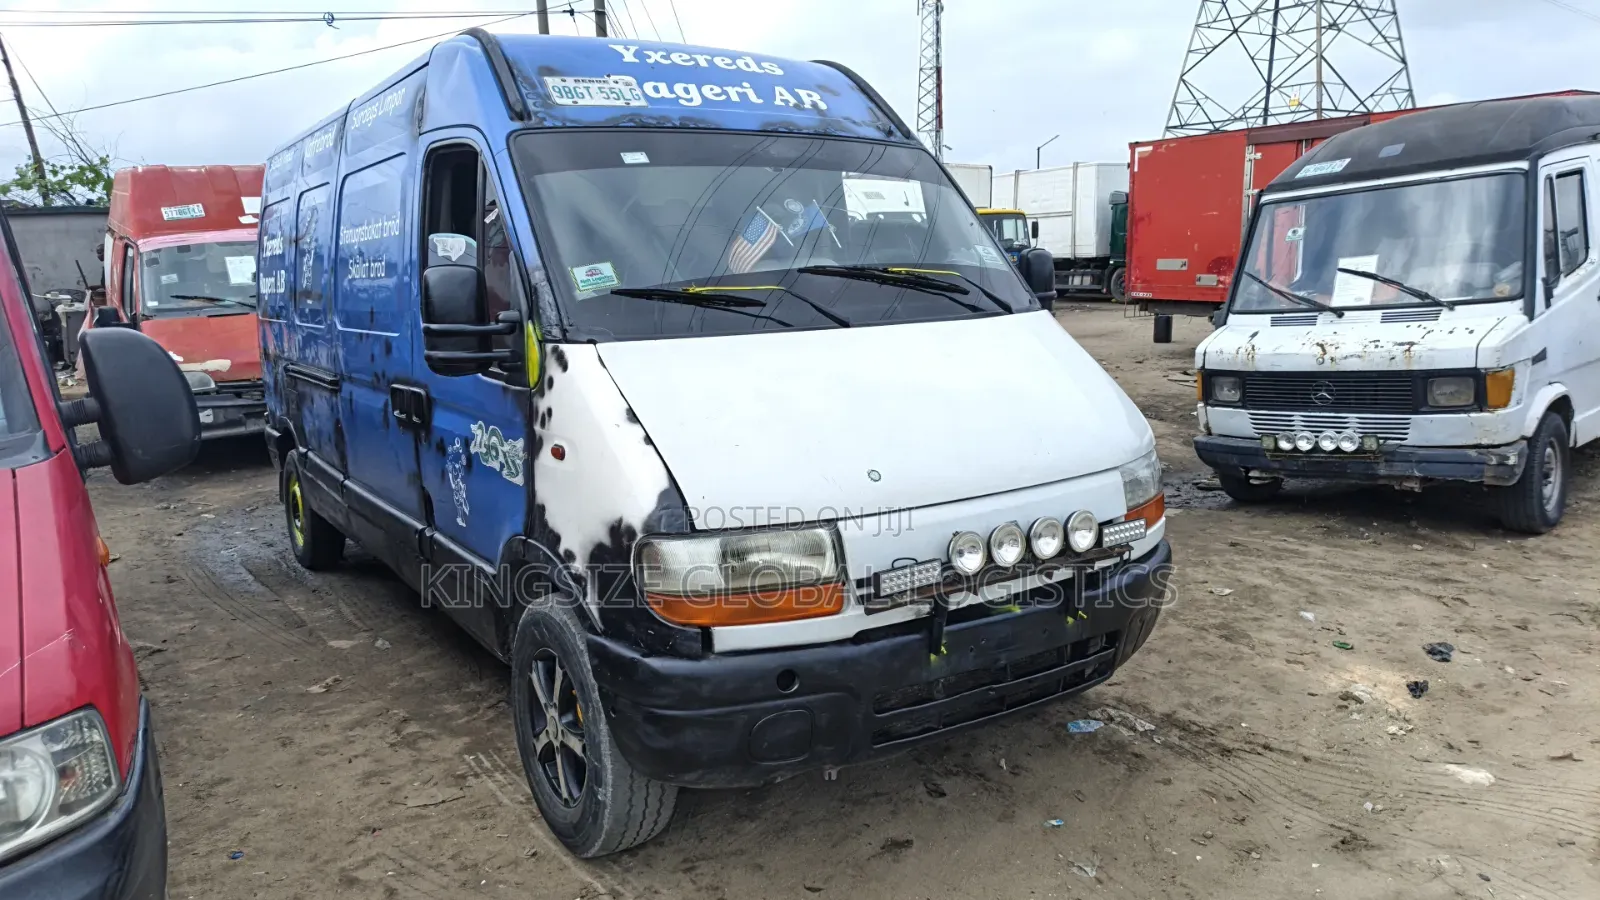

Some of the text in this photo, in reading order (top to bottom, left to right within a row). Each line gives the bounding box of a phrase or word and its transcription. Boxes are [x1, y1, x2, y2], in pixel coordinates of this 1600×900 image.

[608, 44, 784, 76] Yxereds
[614, 77, 763, 106] ageri
[384, 211, 400, 237] bröd
[371, 254, 386, 278] bröd
[277, 270, 286, 293] AB
